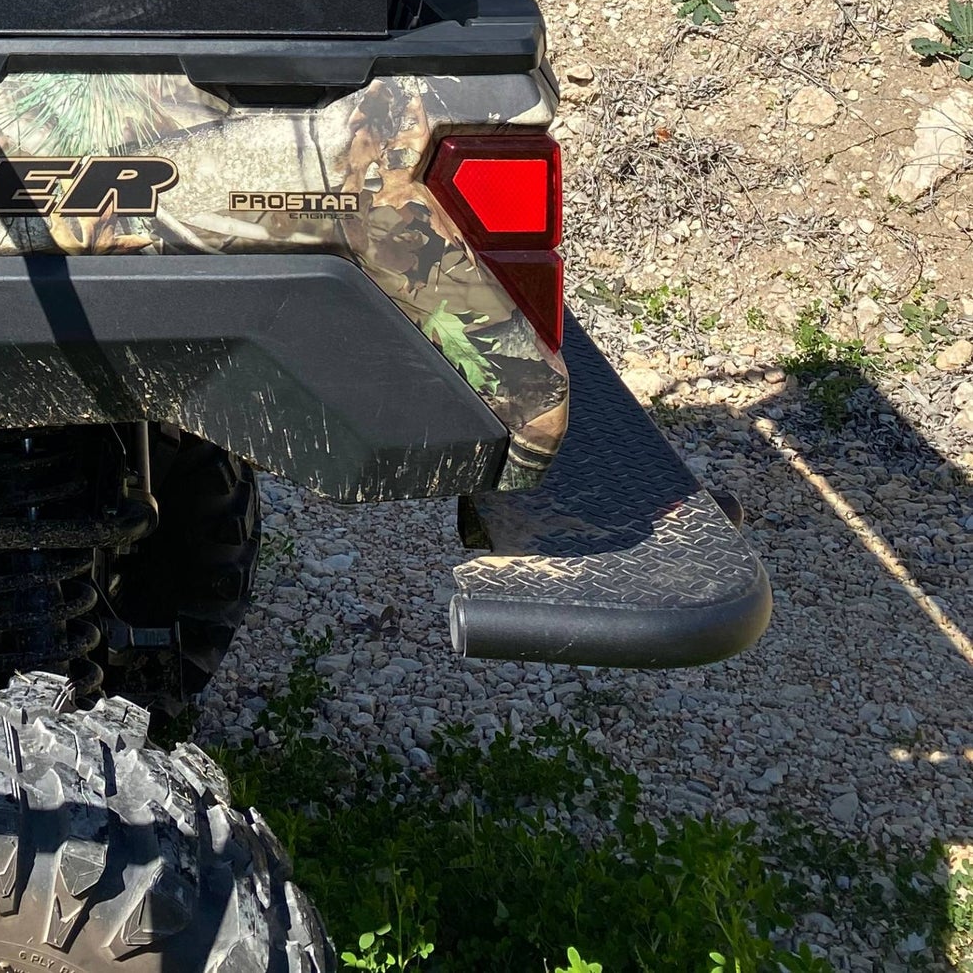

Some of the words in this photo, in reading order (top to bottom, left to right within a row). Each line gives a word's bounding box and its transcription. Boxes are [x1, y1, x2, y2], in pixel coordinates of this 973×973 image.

[230, 192, 359, 211] PROSTAR
[19, 950, 28, 961] 6
[30, 953, 55, 969] PLY
